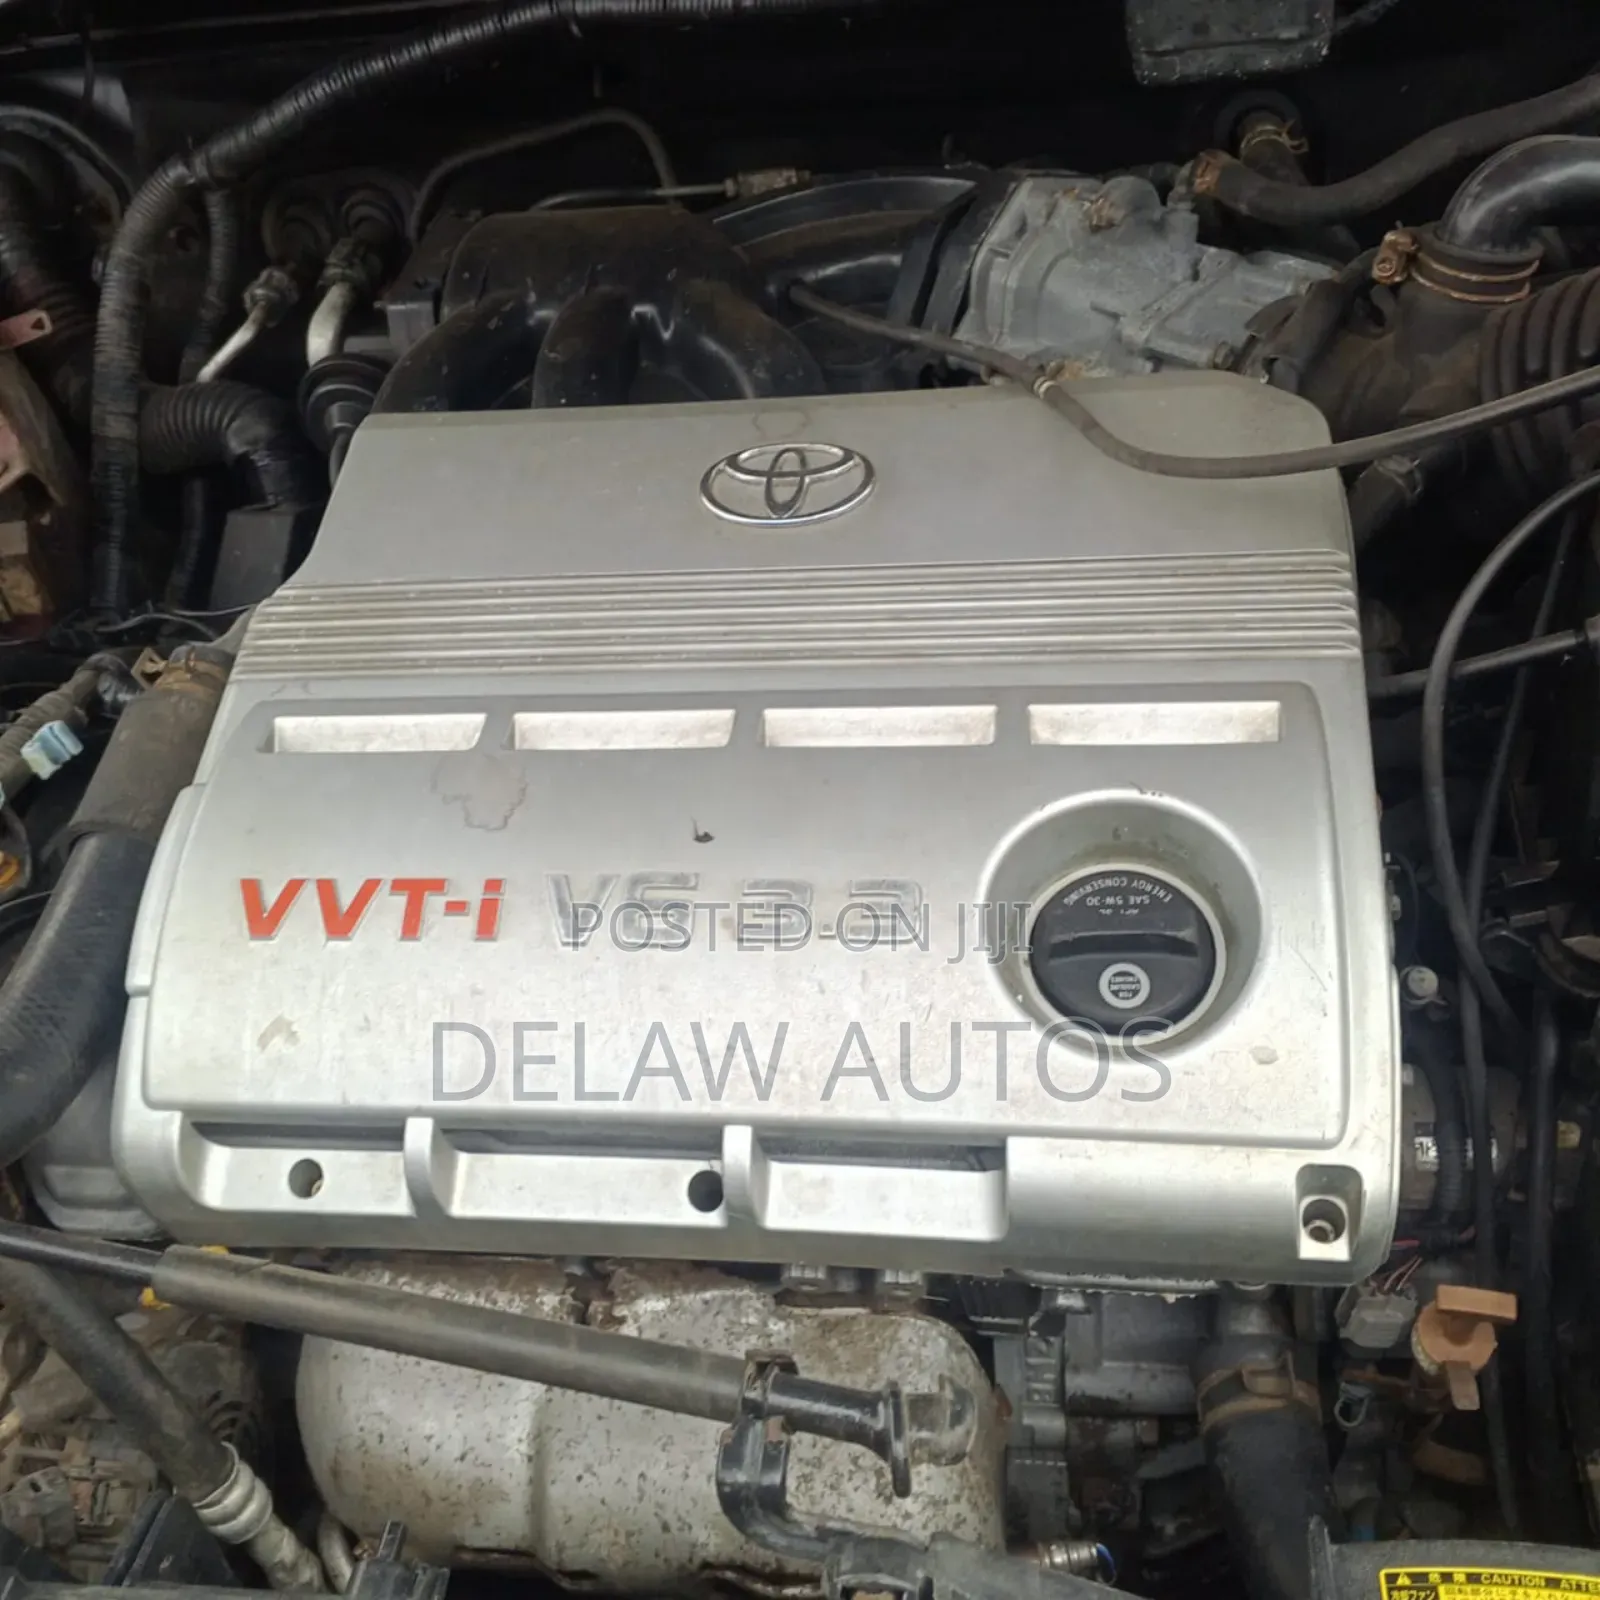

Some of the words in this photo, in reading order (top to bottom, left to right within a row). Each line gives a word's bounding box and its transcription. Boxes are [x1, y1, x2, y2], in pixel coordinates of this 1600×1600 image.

[1063, 876, 1128, 907] CONSERVING
[1128, 894, 1151, 906] SAE
[1131, 879, 1174, 903] ENERGY
[239, 877, 506, 942] VVT-i
[1085, 895, 1124, 907] 5W-30
[1480, 1573, 1547, 1587] CAUTION
